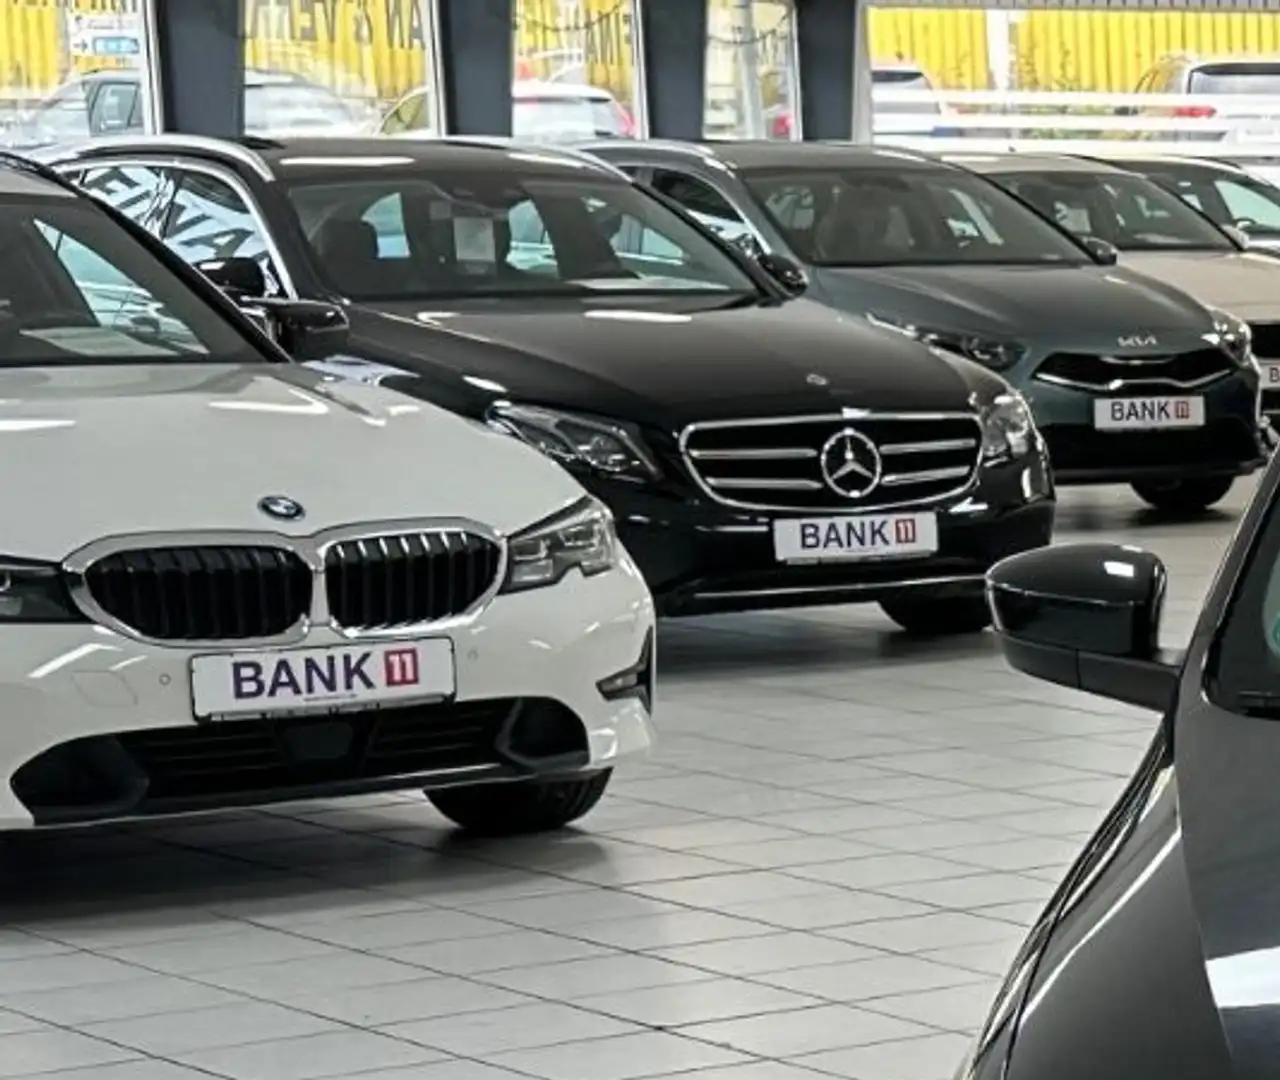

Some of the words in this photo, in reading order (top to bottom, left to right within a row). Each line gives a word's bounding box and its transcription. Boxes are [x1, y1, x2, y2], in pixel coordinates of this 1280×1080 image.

[1110, 400, 1170, 421] BANK
[801, 520, 890, 549] BANK
[896, 519, 915, 543] 11
[232, 652, 376, 699] BANK
[388, 652, 416, 684] 11
